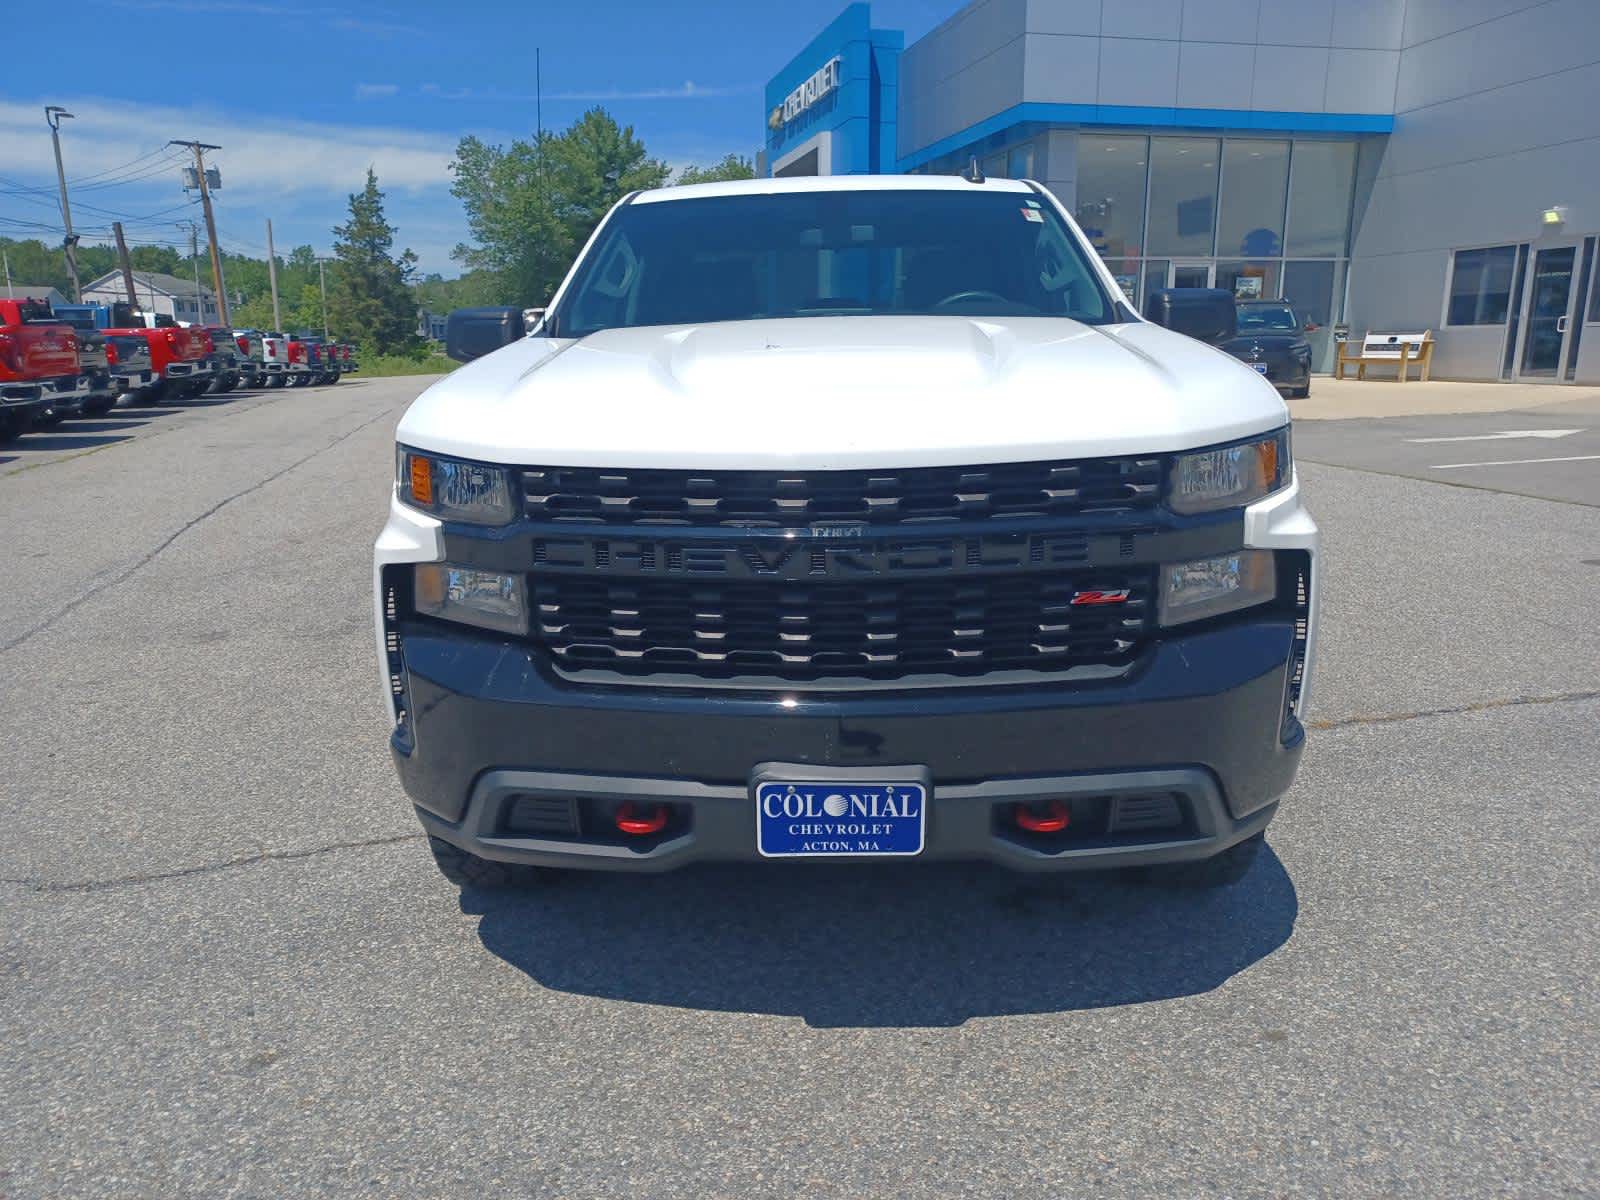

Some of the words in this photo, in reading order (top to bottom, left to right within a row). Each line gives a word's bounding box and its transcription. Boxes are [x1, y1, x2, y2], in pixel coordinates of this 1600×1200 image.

[783, 55, 841, 122] CHEVROLET
[532, 534, 1138, 575] CHEVROLET
[763, 793, 919, 818] COLONIAL
[788, 824, 893, 836] CHEVROLET
[802, 841, 853, 852] ACTON,
[858, 841, 880, 851] MA
